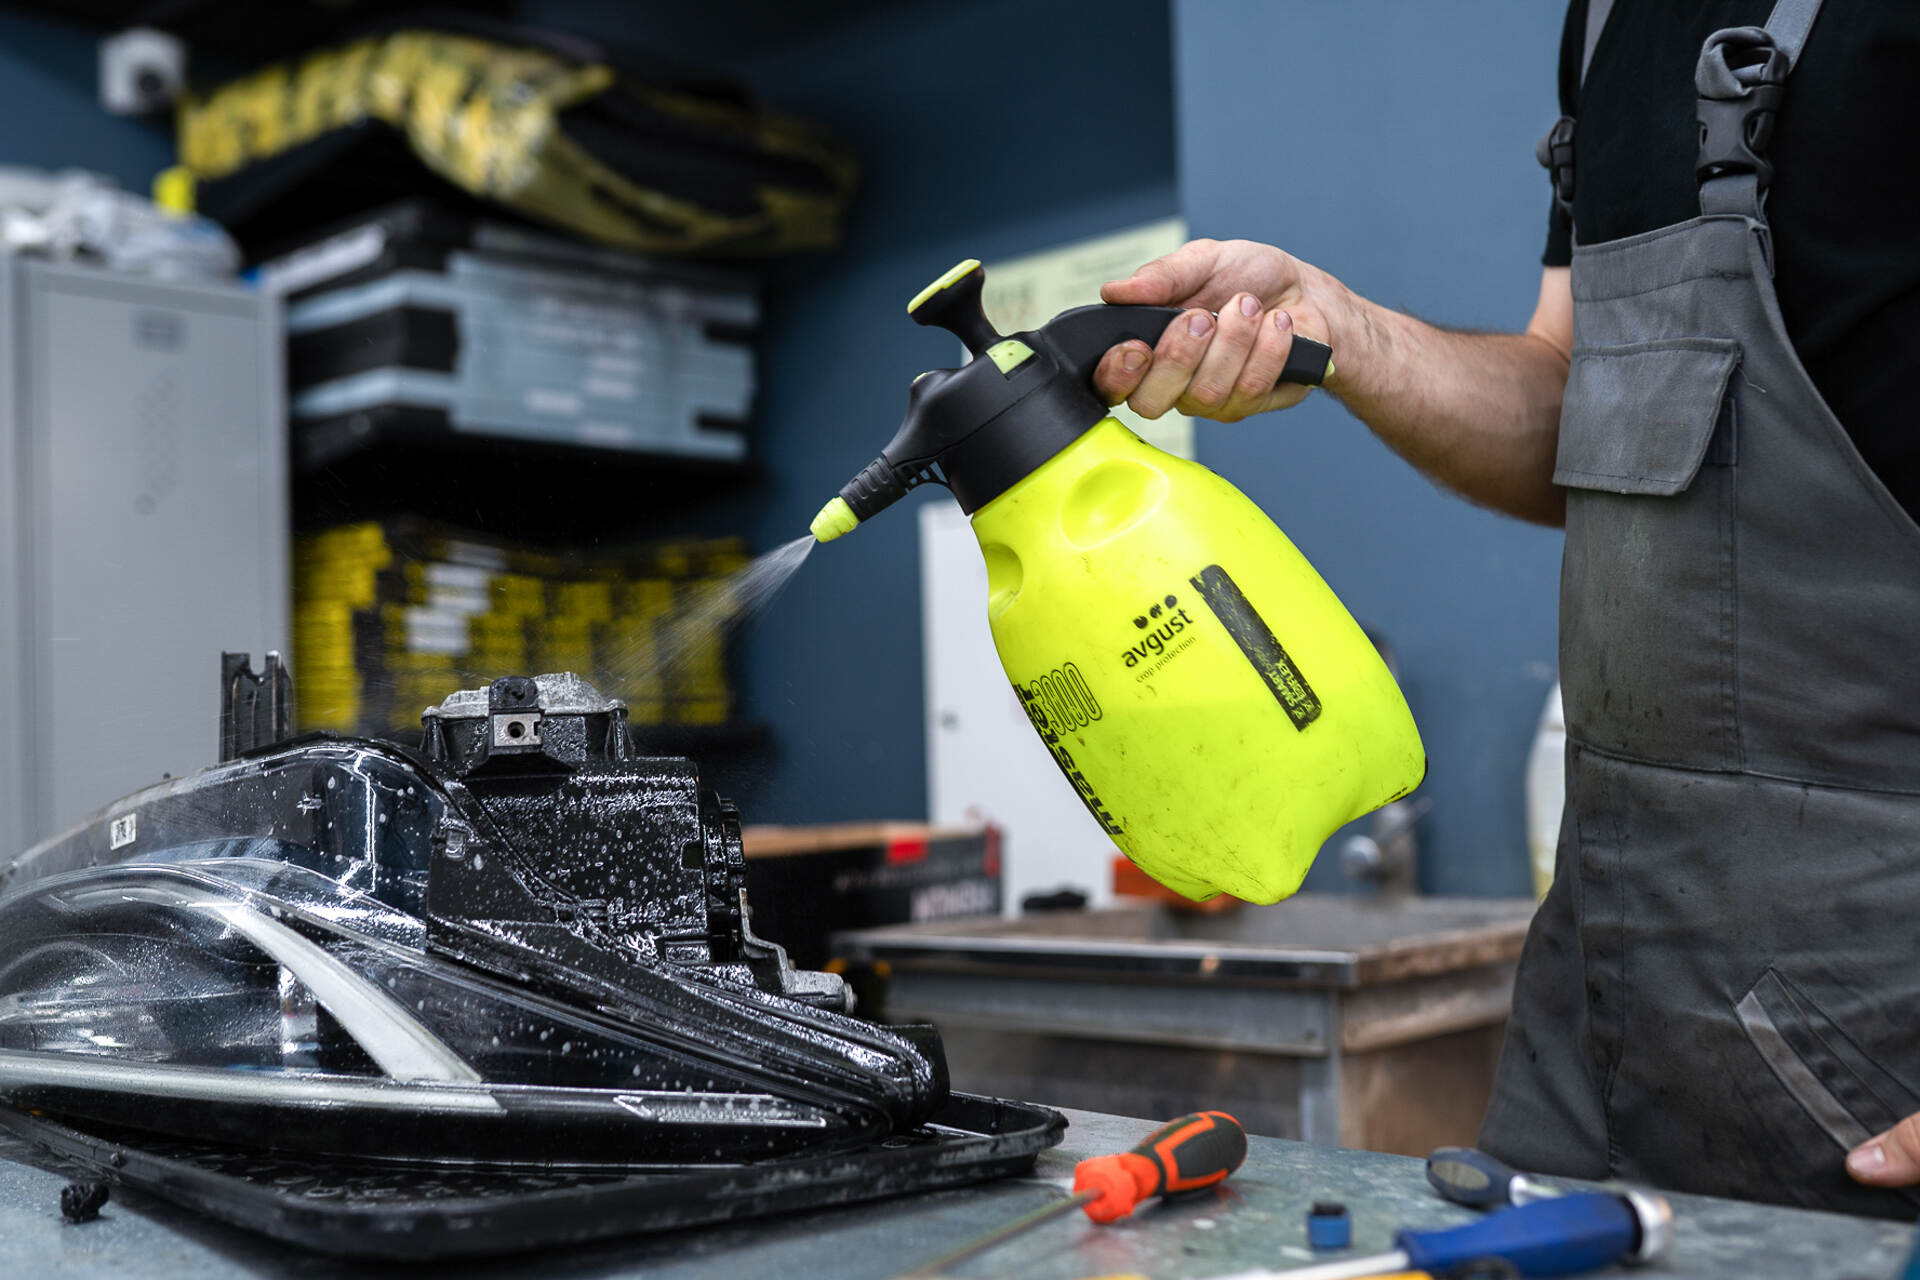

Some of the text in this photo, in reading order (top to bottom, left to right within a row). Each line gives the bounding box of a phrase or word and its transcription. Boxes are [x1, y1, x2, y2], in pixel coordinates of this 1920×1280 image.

[1121, 608, 1194, 668] avgust
[1136, 636, 1197, 683] crop protection
[1029, 662, 1103, 735] 3000
[1014, 684, 1124, 835] master
